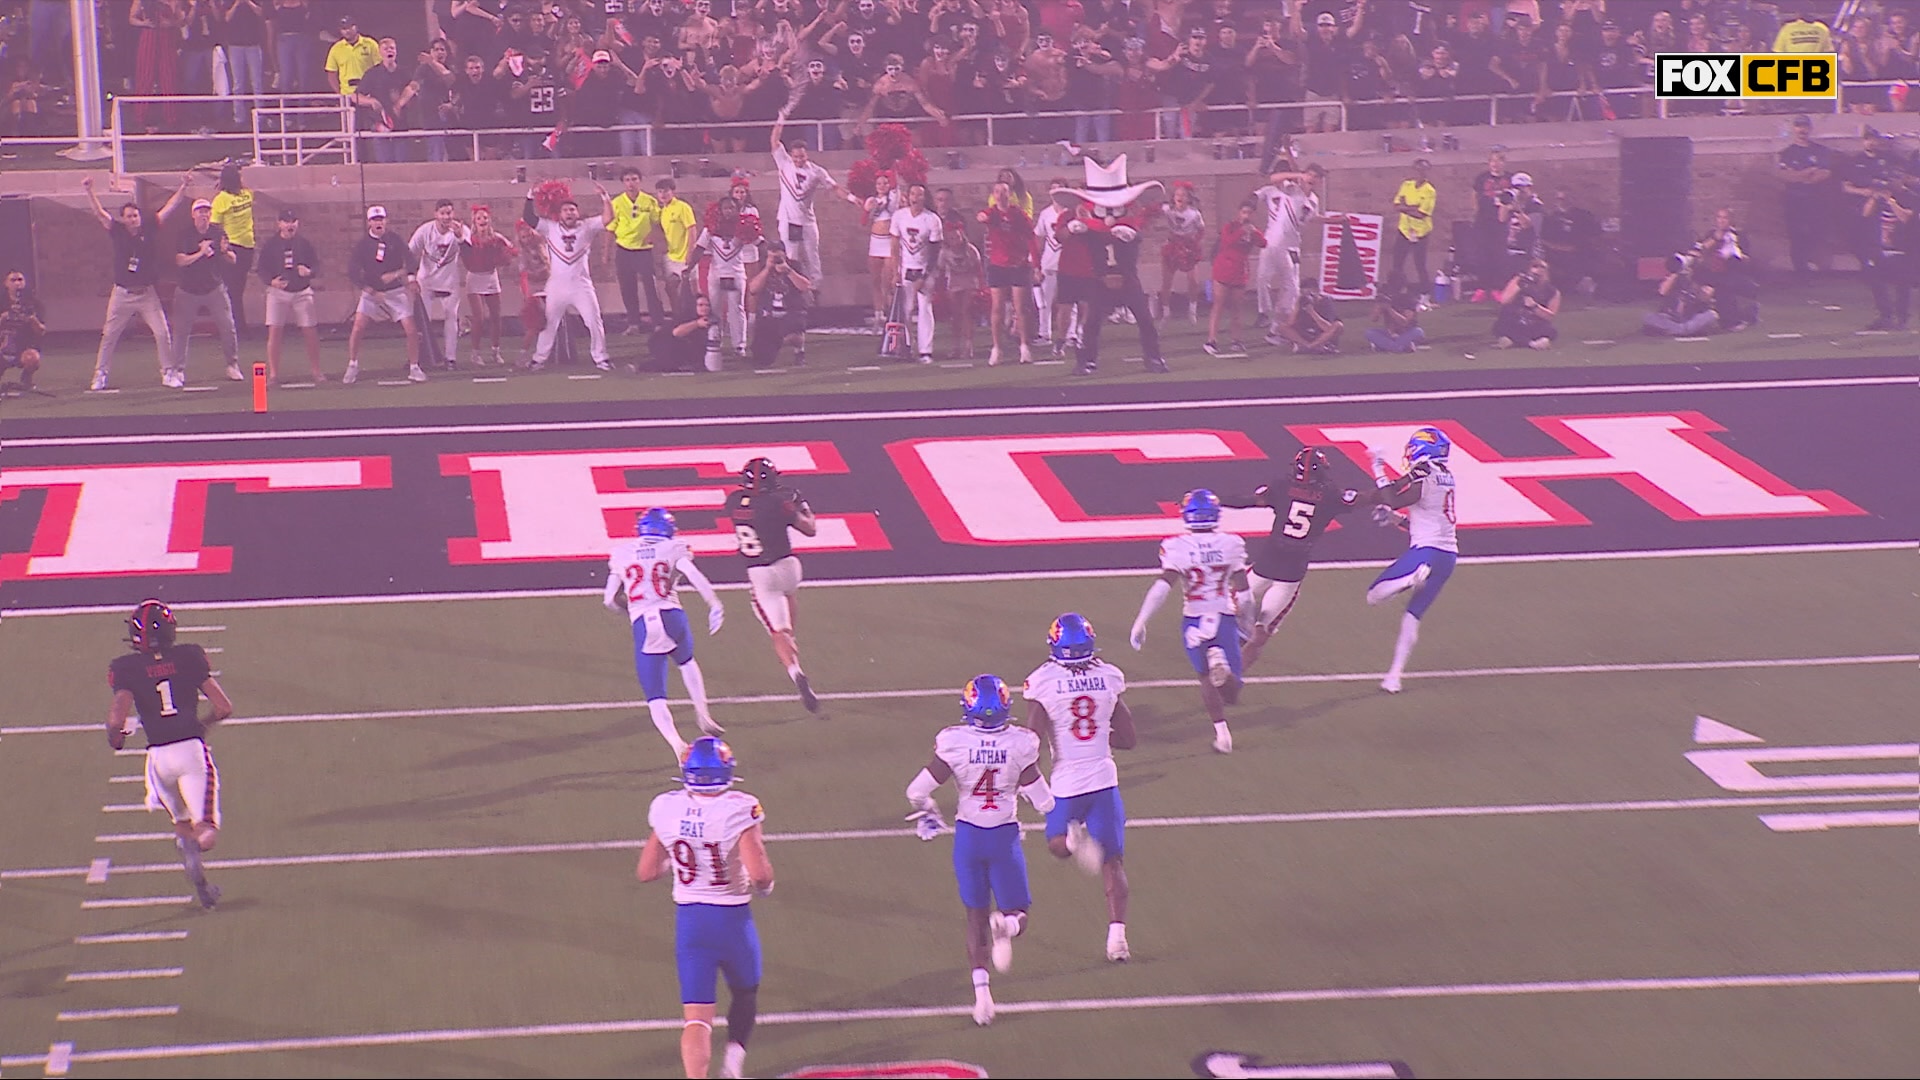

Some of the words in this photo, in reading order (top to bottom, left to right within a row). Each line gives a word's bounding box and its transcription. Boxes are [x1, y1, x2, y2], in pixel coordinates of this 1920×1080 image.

[530, 87, 554, 112] 23
[1105, 244, 1118, 266] 1
[0, 411, 1868, 582] TECH
[1283, 500, 1316, 539] 5
[735, 525, 764, 557] 8
[626, 561, 672, 602] 26
[1186, 566, 1230, 601] 27
[156, 680, 178, 716] 1
[1056, 680, 1066, 694] J.
[1067, 677, 1107, 692] KAMARA
[1071, 695, 1097, 741] 8
[968, 749, 1007, 764] LATHAN
[972, 768, 1000, 810] 4
[680, 820, 704, 838] BRAY
[673, 840, 731, 885] 91
